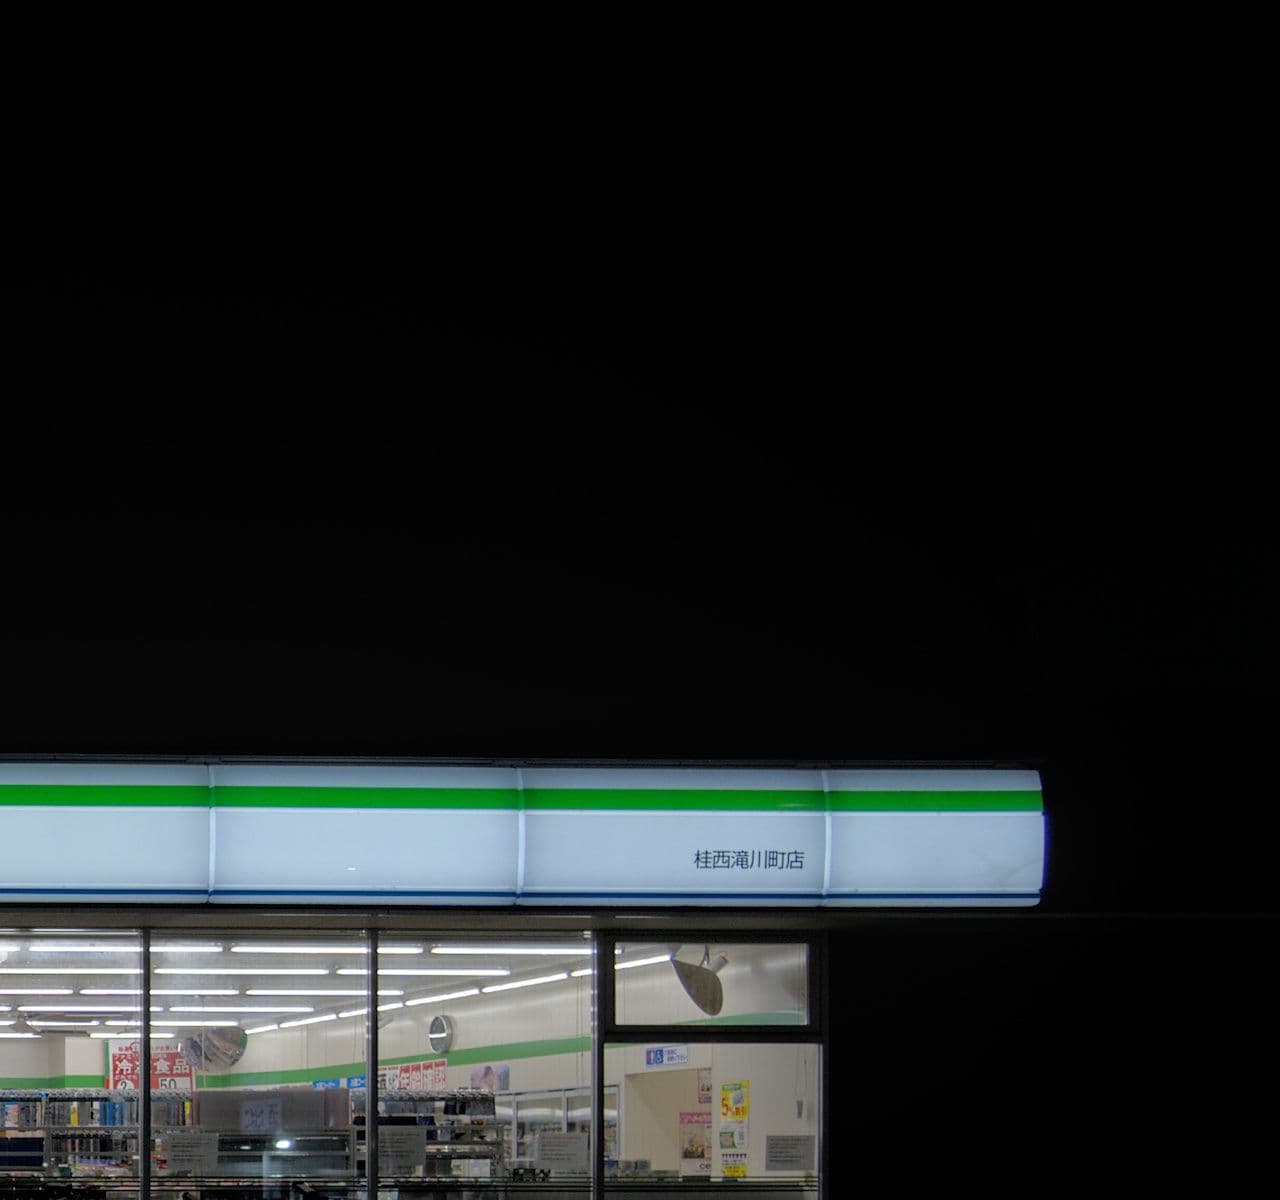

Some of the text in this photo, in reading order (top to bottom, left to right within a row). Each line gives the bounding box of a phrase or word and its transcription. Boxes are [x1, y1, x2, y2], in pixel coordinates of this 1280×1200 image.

[694, 850, 805, 869] 桂西滝川町店
